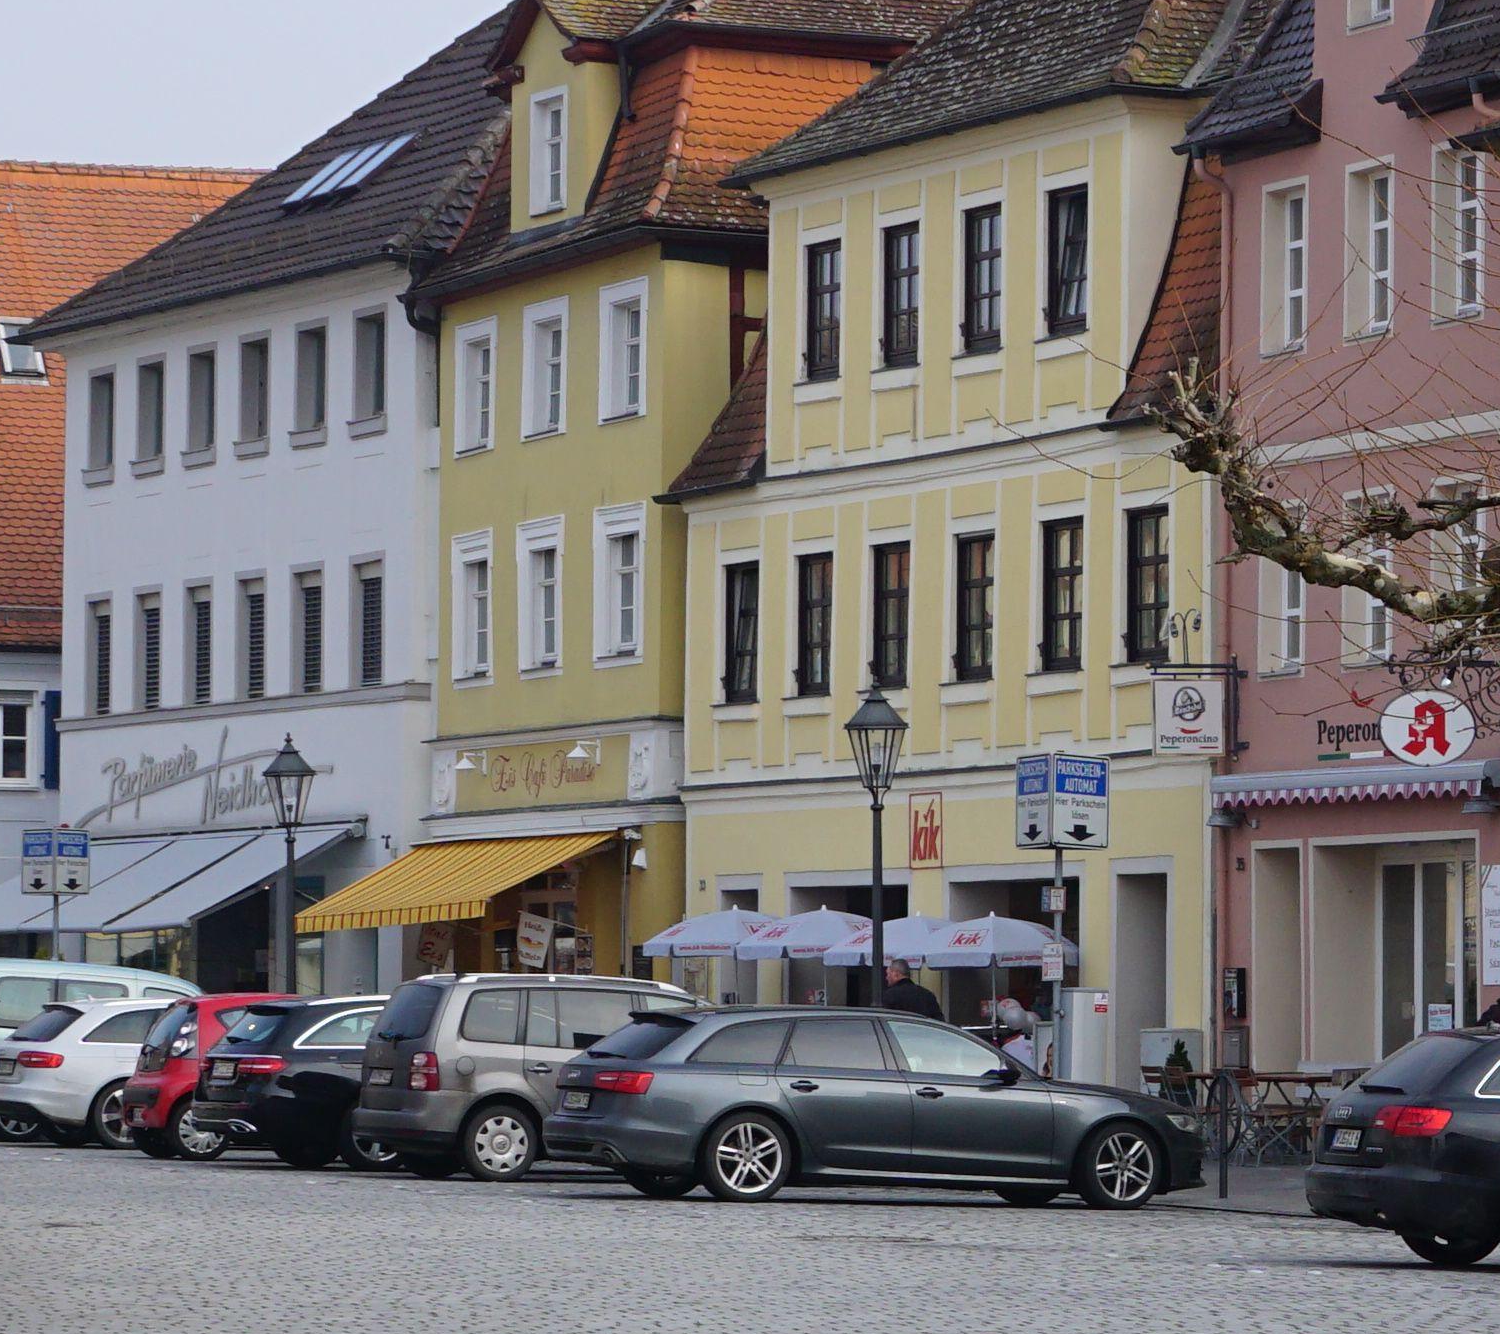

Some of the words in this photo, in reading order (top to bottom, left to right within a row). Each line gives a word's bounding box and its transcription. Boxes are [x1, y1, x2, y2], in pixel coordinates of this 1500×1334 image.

[1160, 734, 1219, 745] Peperoncino
[1316, 720, 1381, 751] Peperon
[1057, 760, 1105, 778] PARKSCHEIN-
[101, 743, 197, 823] Parfümerie
[1064, 777, 1098, 794] AUTOMAT
[955, 932, 982, 946] kik
